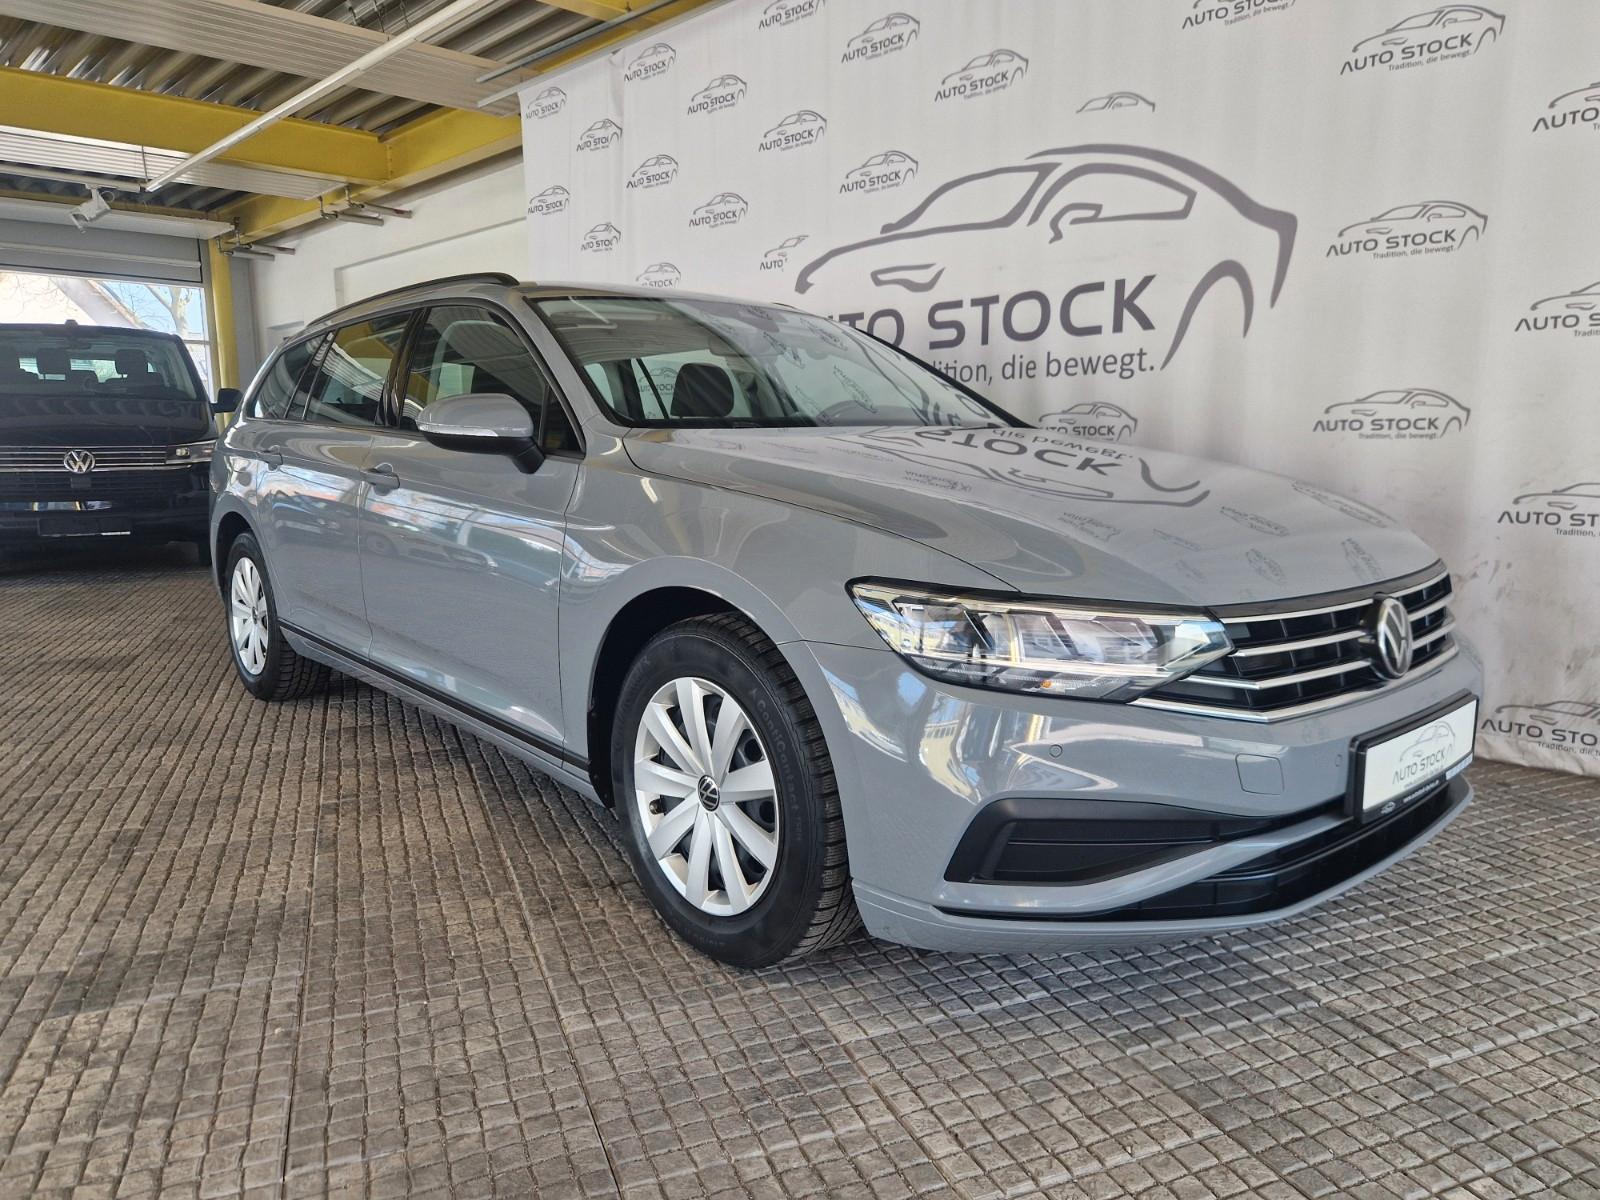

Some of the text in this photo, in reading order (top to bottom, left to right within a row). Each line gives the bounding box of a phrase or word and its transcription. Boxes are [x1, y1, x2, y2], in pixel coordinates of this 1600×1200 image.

[758, 12, 782, 30] AUTO
[784, 0, 814, 19] STOCK
[1181, 7, 1229, 30] AUTO
[841, 45, 868, 64] AUTO
[870, 32, 905, 53] STOCK
[1340, 32, 1473, 75] AUTO STOCK
[624, 68, 642, 82] AUTO
[643, 59, 666, 75] STOCK
[934, 84, 967, 102] AUTO
[969, 70, 1009, 92] STOCK
[540, 102, 559, 114] STOCK
[687, 101, 709, 116] AUTO
[710, 91, 736, 108] STOCK
[1532, 107, 1599, 132] AUTO
[758, 138, 782, 153] AUTO
[784, 128, 814, 145] STOCK
[646, 170, 670, 183] STOCK
[839, 180, 866, 194] AUTO
[869, 169, 901, 187] STOCK
[527, 204, 544, 215] AUTO
[689, 215, 711, 227] AUTO
[712, 209, 738, 223] STOCK
[1326, 228, 1457, 258] AUTO STOCK
[759, 259, 784, 271] AUTO
[649, 278, 673, 288] STOCK
[927, 274, 1157, 351] STOCK
[1514, 314, 1580, 333] AUTO
[1002, 354, 1037, 381] die
[1046, 347, 1155, 380] bewegt.
[1072, 425, 1115, 437] STOCK
[1312, 416, 1439, 432] AUTO STOCK
[1497, 510, 1561, 526] AUTO
[1480, 719, 1598, 747] AUTO STO
[1392, 762, 1418, 784] AUTO
[1419, 746, 1445, 771] STOCK
